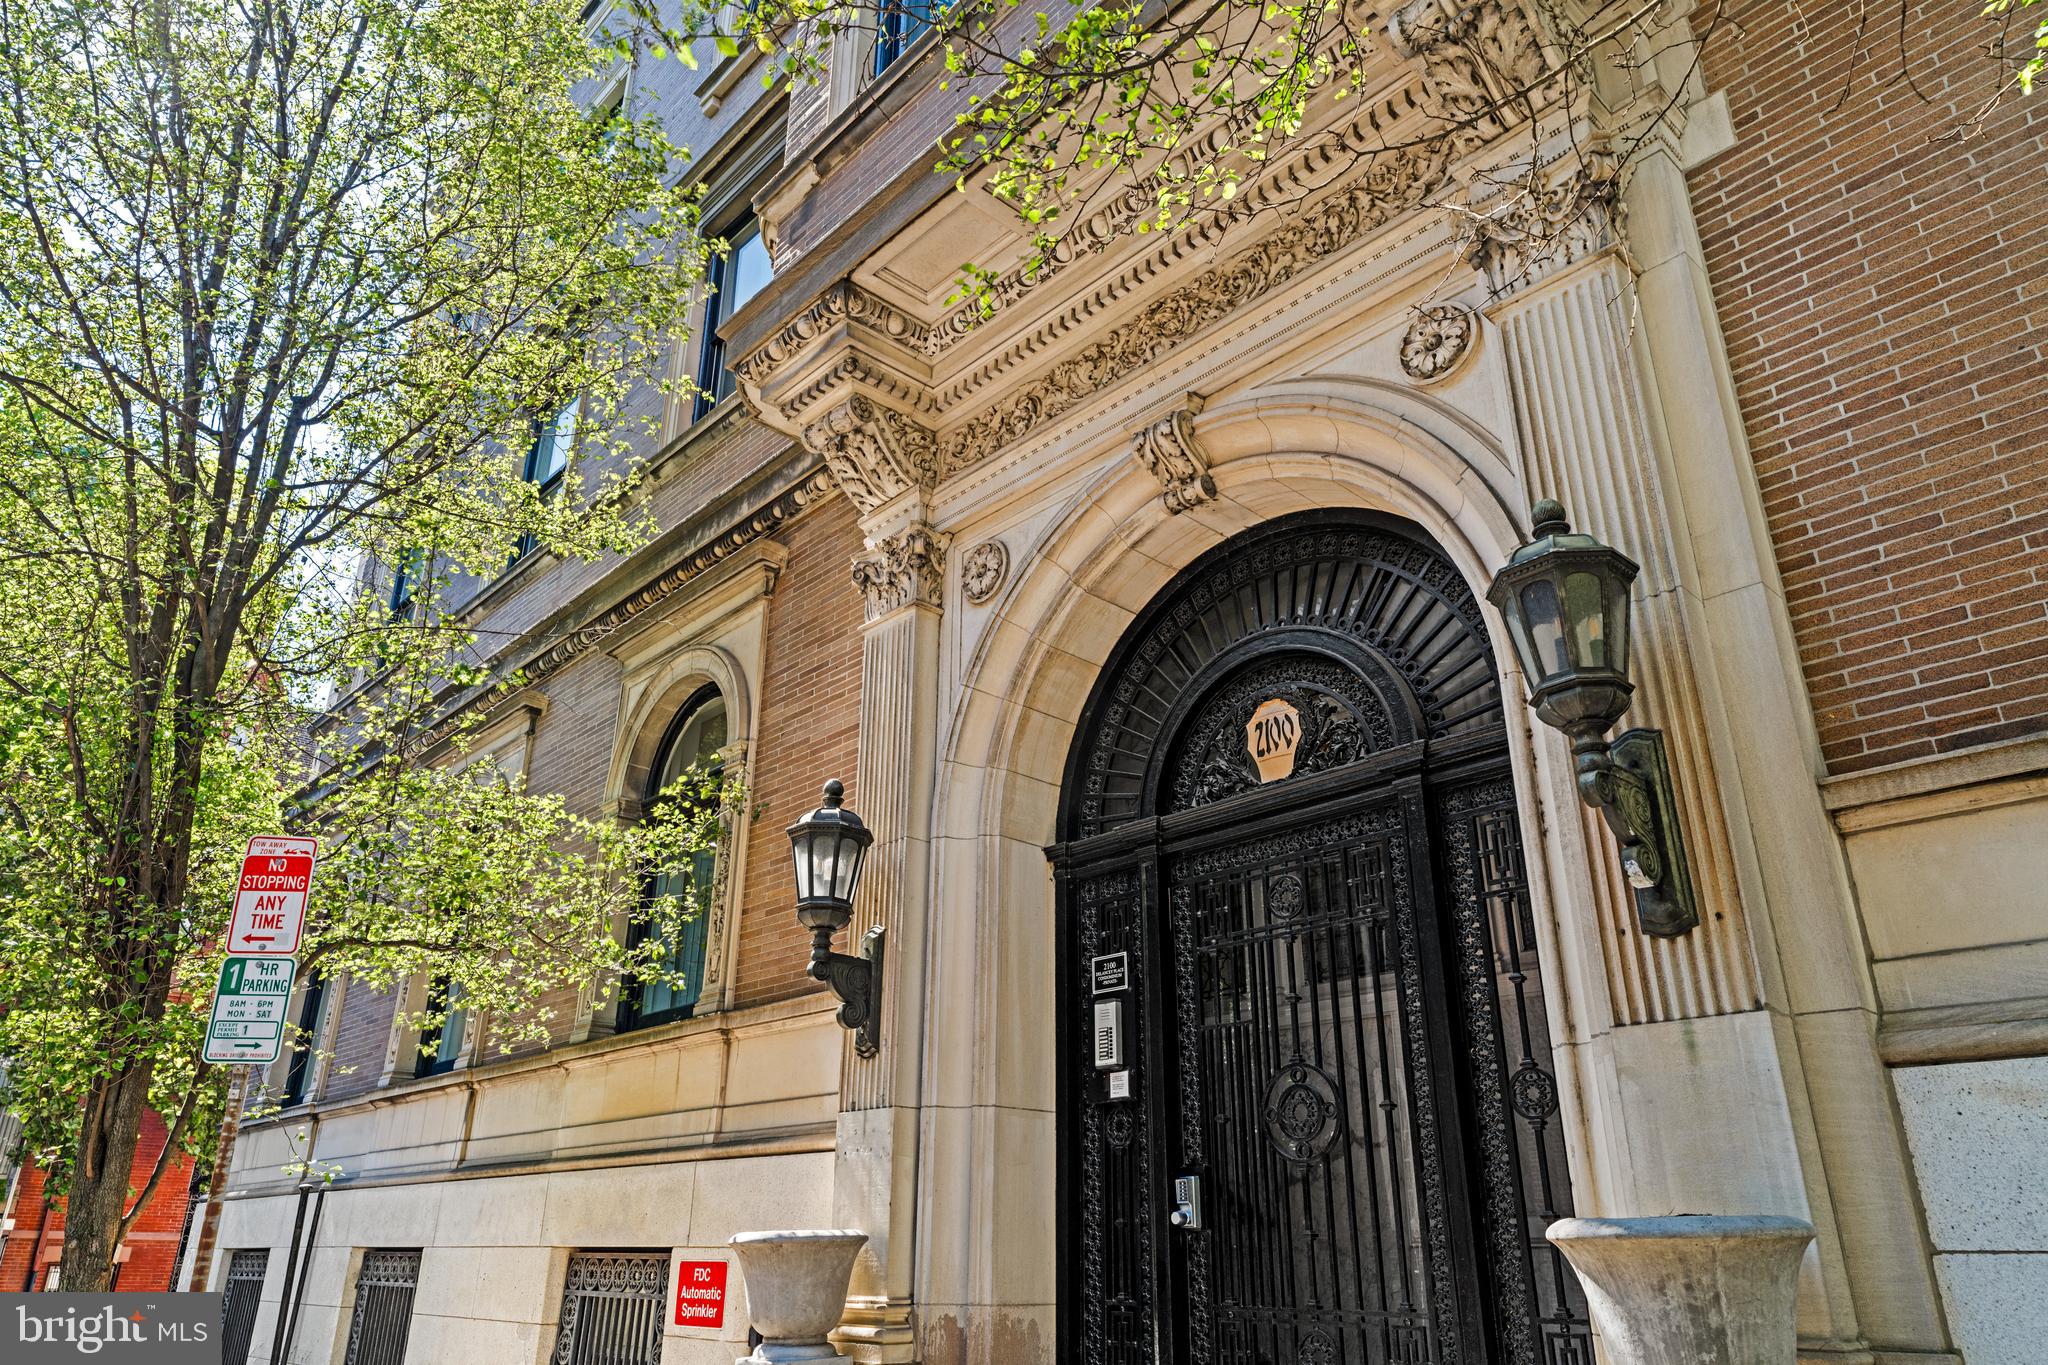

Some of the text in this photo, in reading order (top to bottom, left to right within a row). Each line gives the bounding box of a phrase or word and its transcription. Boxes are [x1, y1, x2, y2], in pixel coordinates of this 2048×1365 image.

[1254, 713, 1295, 758] 2100
[268, 858, 287, 872] NO
[242, 875, 306, 889] STOPPING
[255, 896, 287, 911] ANY
[251, 914, 286, 929] TIME
[260, 963, 279, 976] HR
[1103, 961, 1117, 970] 2100
[229, 963, 241, 989] 1
[242, 979, 288, 992] PARKING
[229, 1000, 246, 1008] 8AM
[257, 1000, 274, 1008] 6PM
[256, 1010, 272, 1018] SAT
[243, 1025, 248, 1035] 1
[693, 1268, 711, 1282] FDC
[680, 1285, 722, 1300] Automatic
[681, 1303, 718, 1319] Sprinkler
